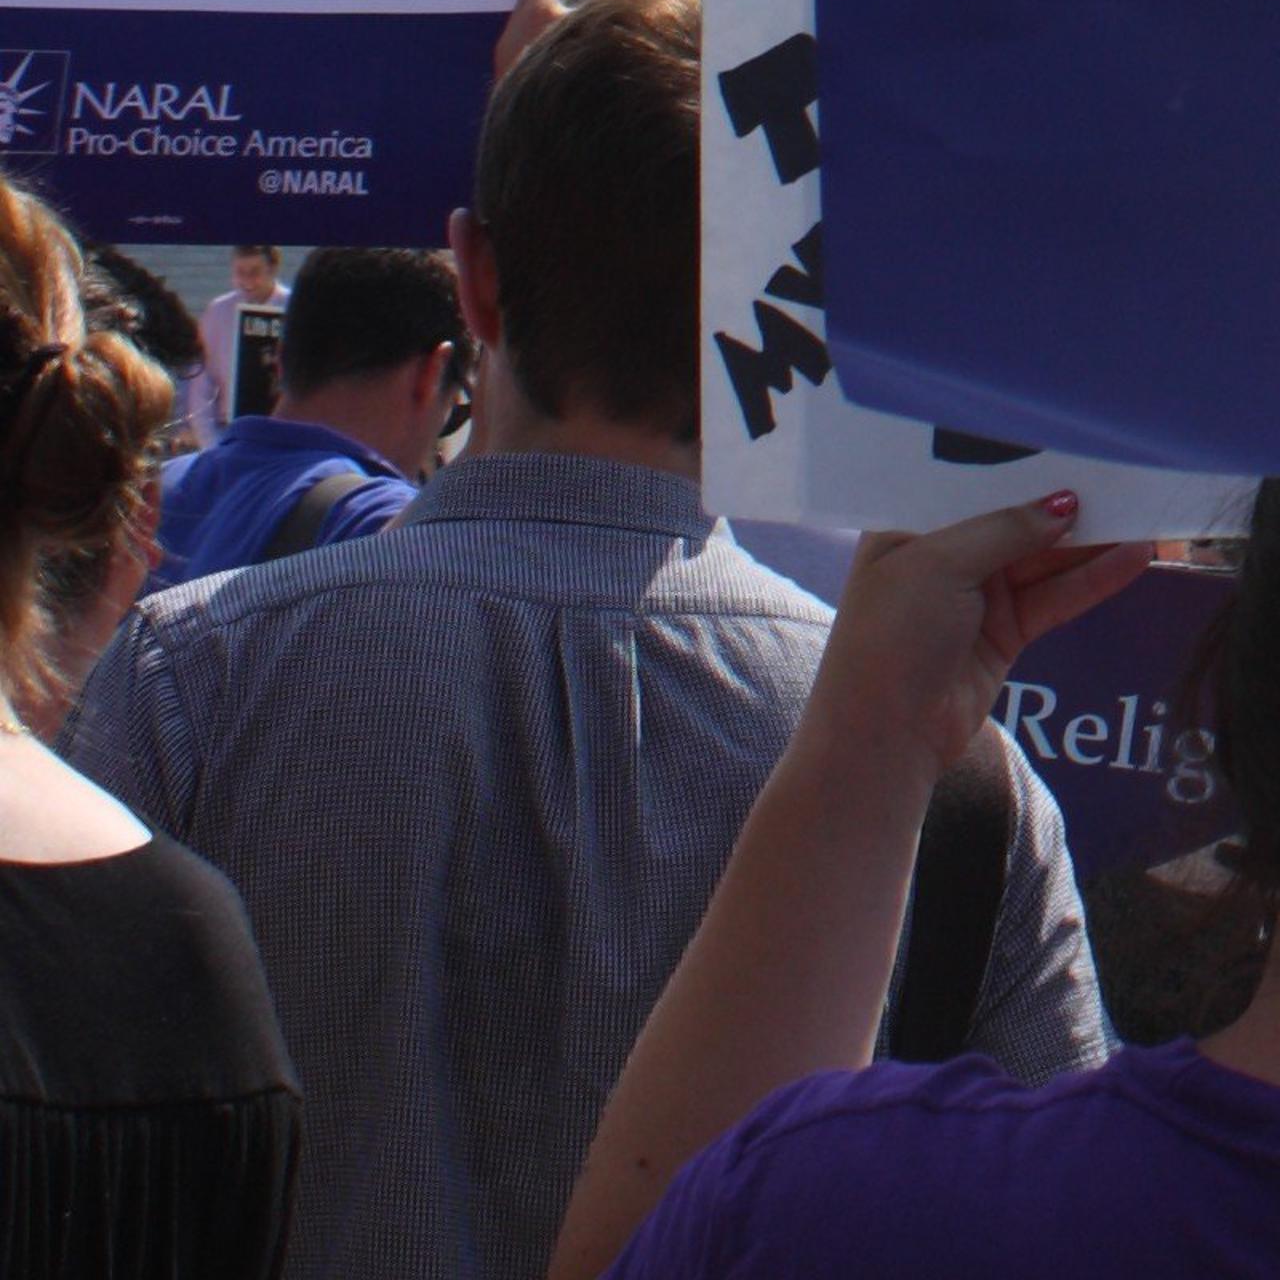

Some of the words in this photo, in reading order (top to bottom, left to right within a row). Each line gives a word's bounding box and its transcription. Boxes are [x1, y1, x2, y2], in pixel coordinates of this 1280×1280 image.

[69, 83, 243, 122] NARAL
[67, 127, 237, 157] Pro-Choice
[243, 128, 373, 160] America
[259, 169, 369, 196] @NARAL
